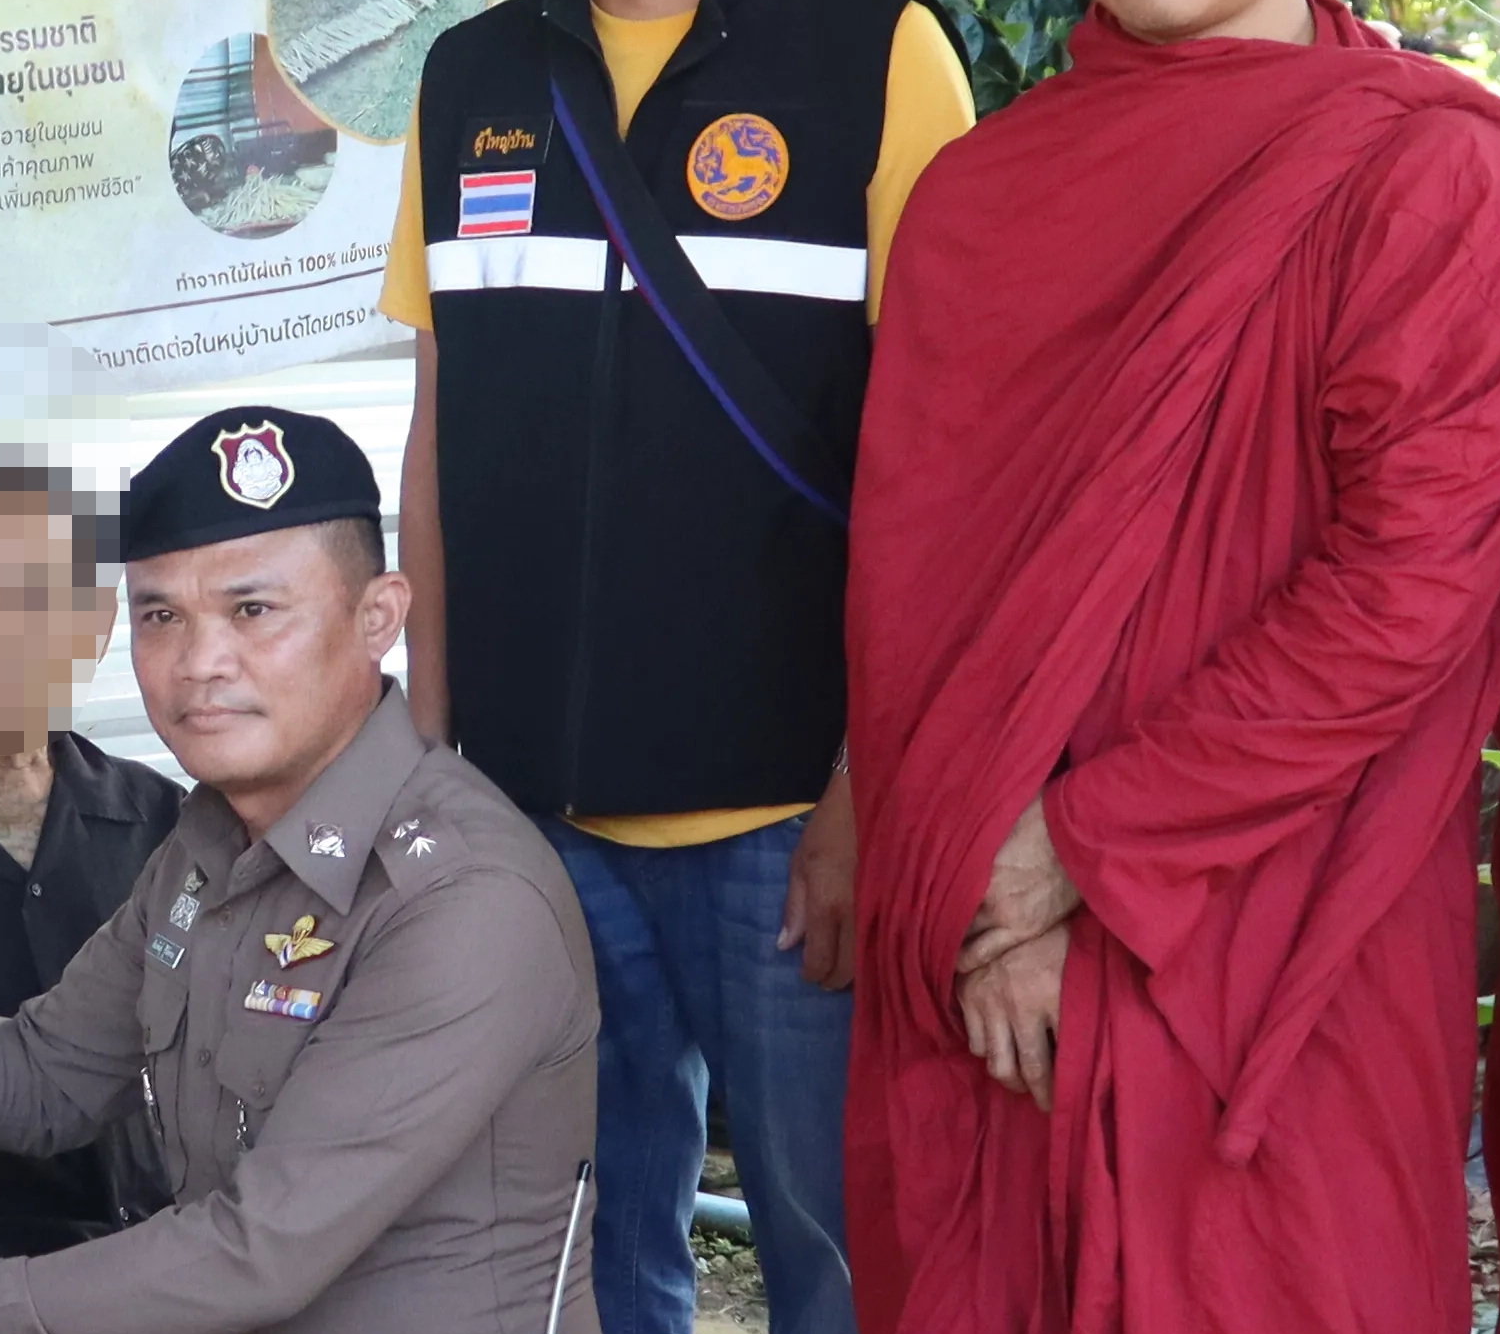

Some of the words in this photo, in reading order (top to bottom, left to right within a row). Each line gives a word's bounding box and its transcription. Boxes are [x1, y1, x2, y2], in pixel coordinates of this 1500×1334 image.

[176, 255, 293, 293] ทำจากไม้ไผ่แท้
[297, 250, 337, 275] 100%
